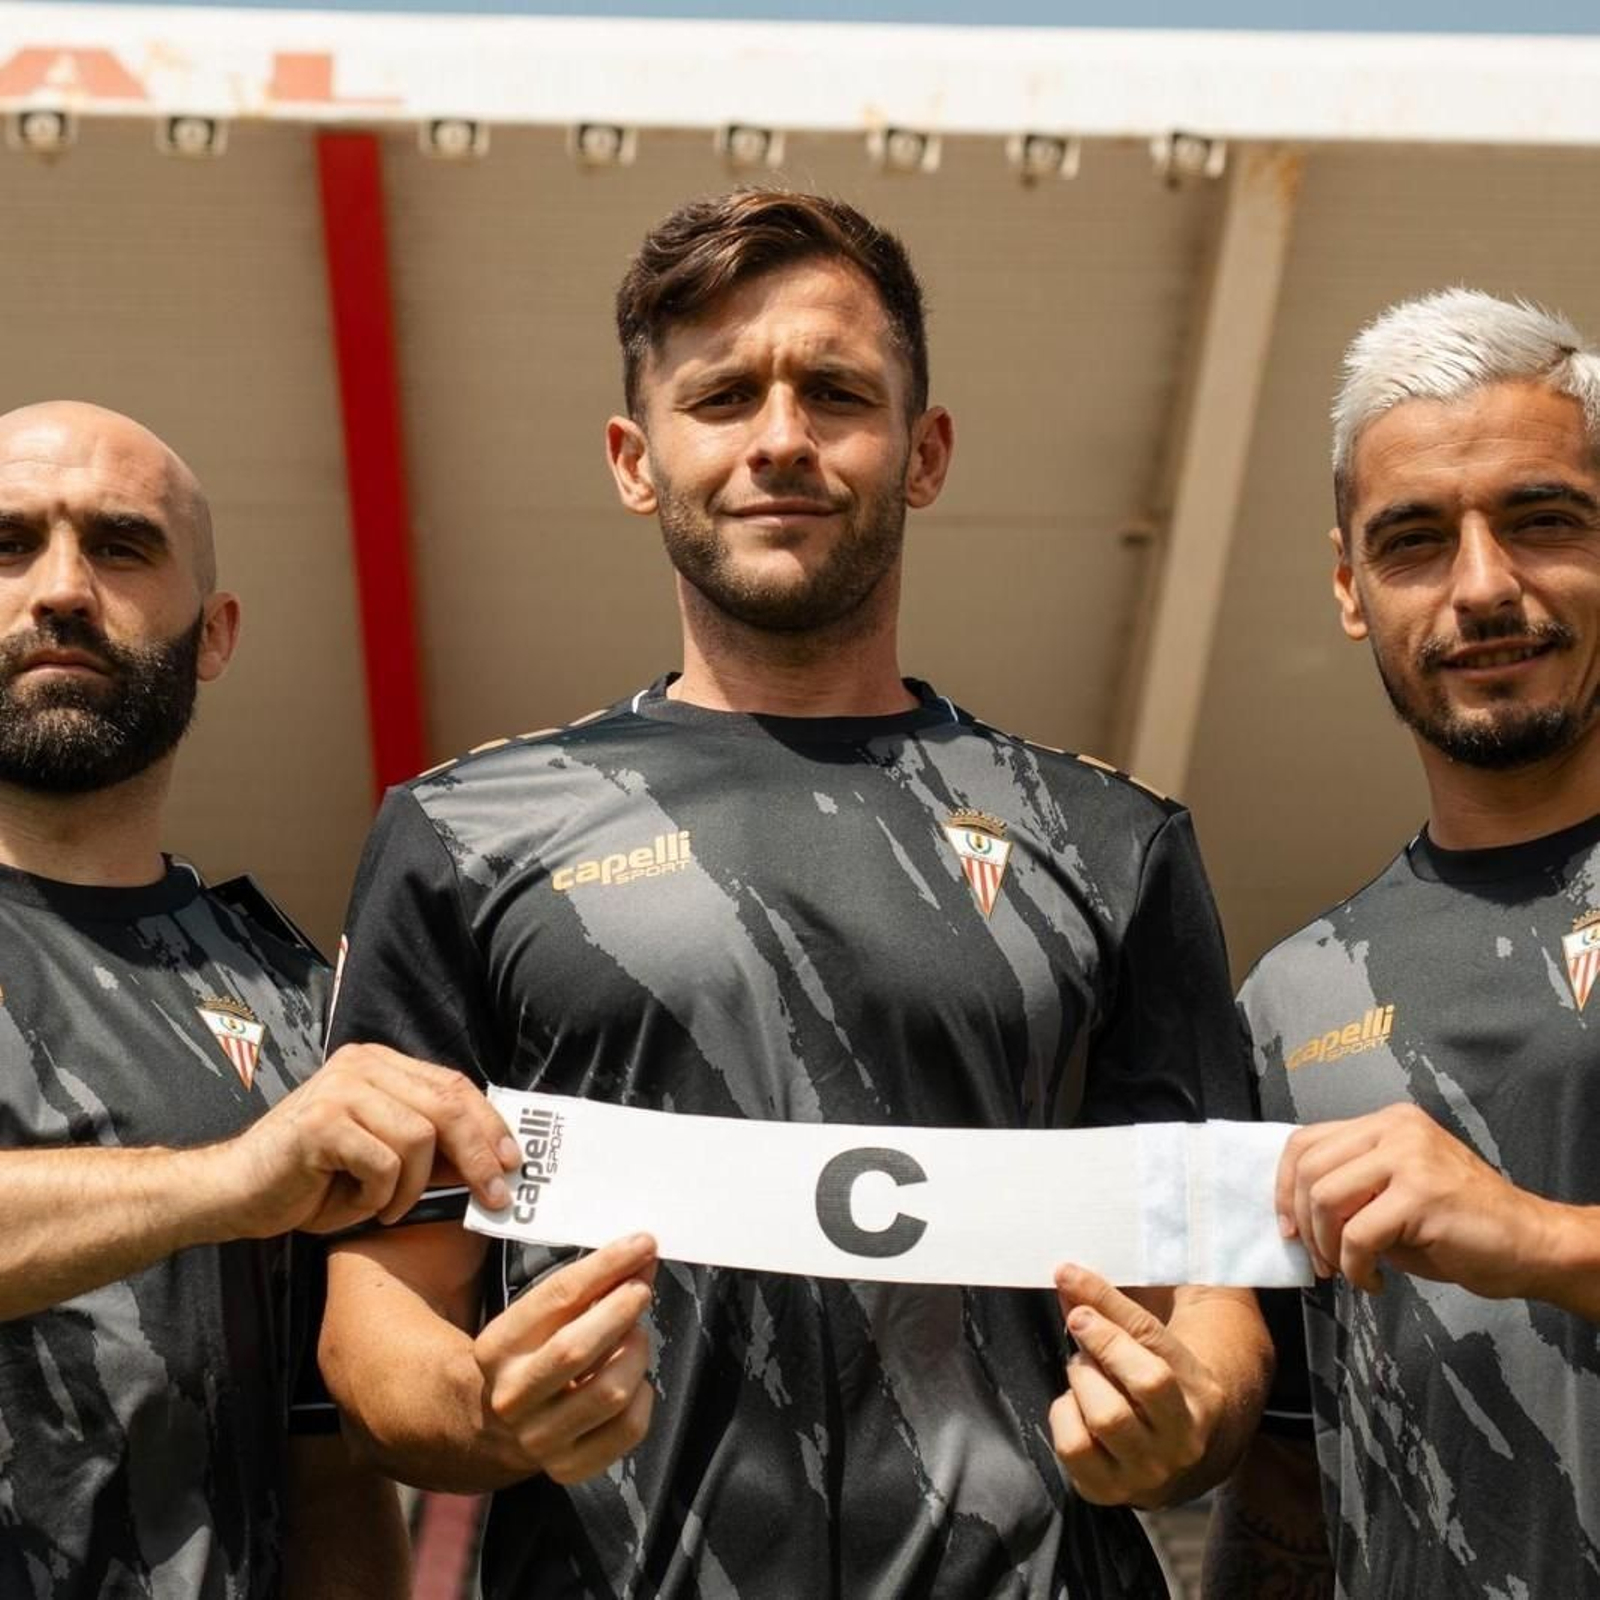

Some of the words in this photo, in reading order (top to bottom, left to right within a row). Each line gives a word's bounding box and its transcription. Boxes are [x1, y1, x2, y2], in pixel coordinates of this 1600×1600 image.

[552, 831, 691, 890] capelli
[615, 859, 689, 885] SPORT
[1285, 1004, 1394, 1071] capelli
[513, 1108, 553, 1224] capelli
[546, 1112, 565, 1174] SPORT
[815, 1147, 928, 1258] C
